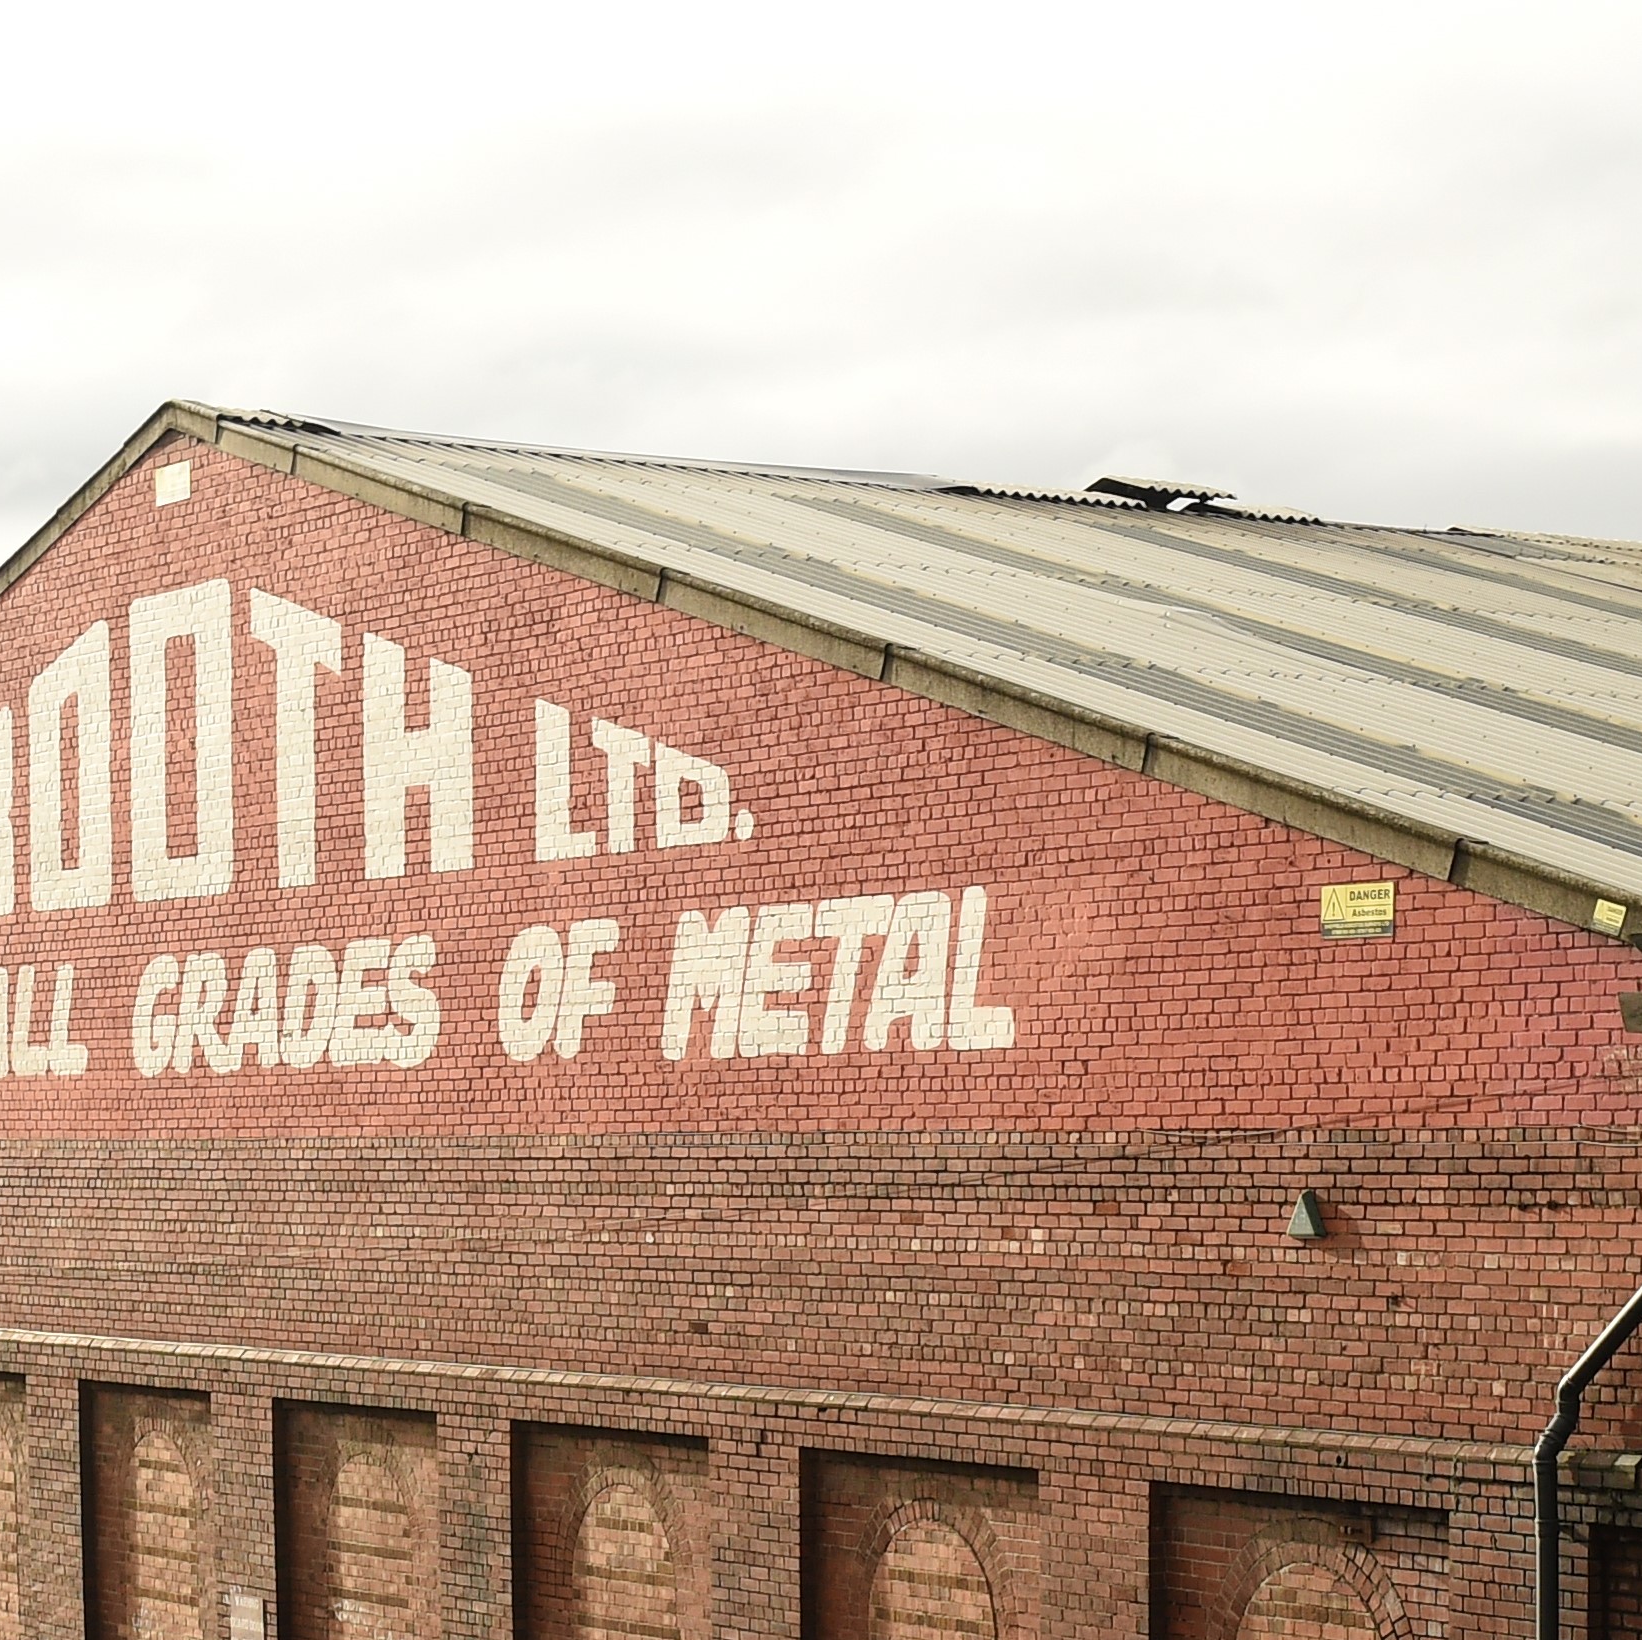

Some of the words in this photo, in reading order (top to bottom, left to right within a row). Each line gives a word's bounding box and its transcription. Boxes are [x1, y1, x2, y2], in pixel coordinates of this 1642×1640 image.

[535, 697, 755, 861] LTD.
[1349, 888, 1391, 902] DANGER
[1351, 907, 1388, 918] Asbestos
[133, 934, 440, 1080] GRADES
[497, 918, 619, 1062] OF
[663, 885, 1015, 1062] METAL
